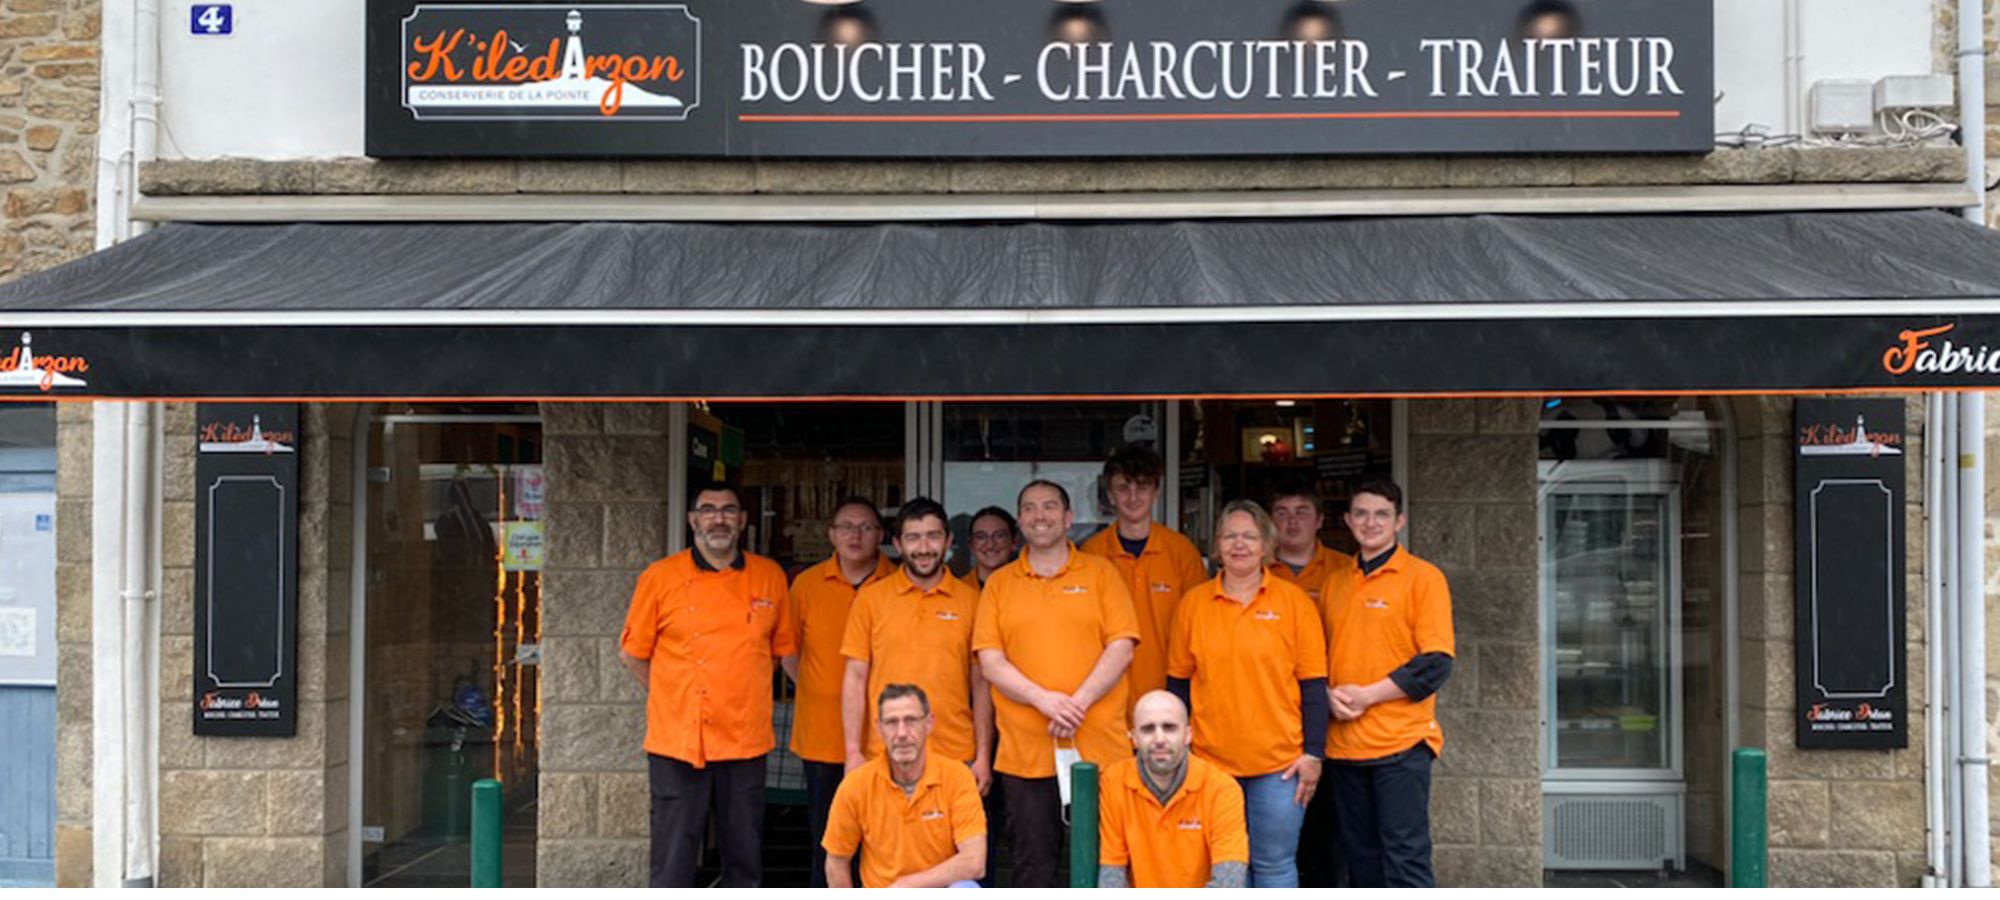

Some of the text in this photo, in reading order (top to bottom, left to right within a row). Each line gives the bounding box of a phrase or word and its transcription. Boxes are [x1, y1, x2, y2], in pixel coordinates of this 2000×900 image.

[198, 7, 224, 32] 4
[740, 42, 994, 101] BOUCHER
[1036, 39, 1379, 100] CHARCUTIER
[1420, 37, 1684, 97] TRAITEUR
[419, 89, 590, 100] CONSERVERIE DE LA POINTE
